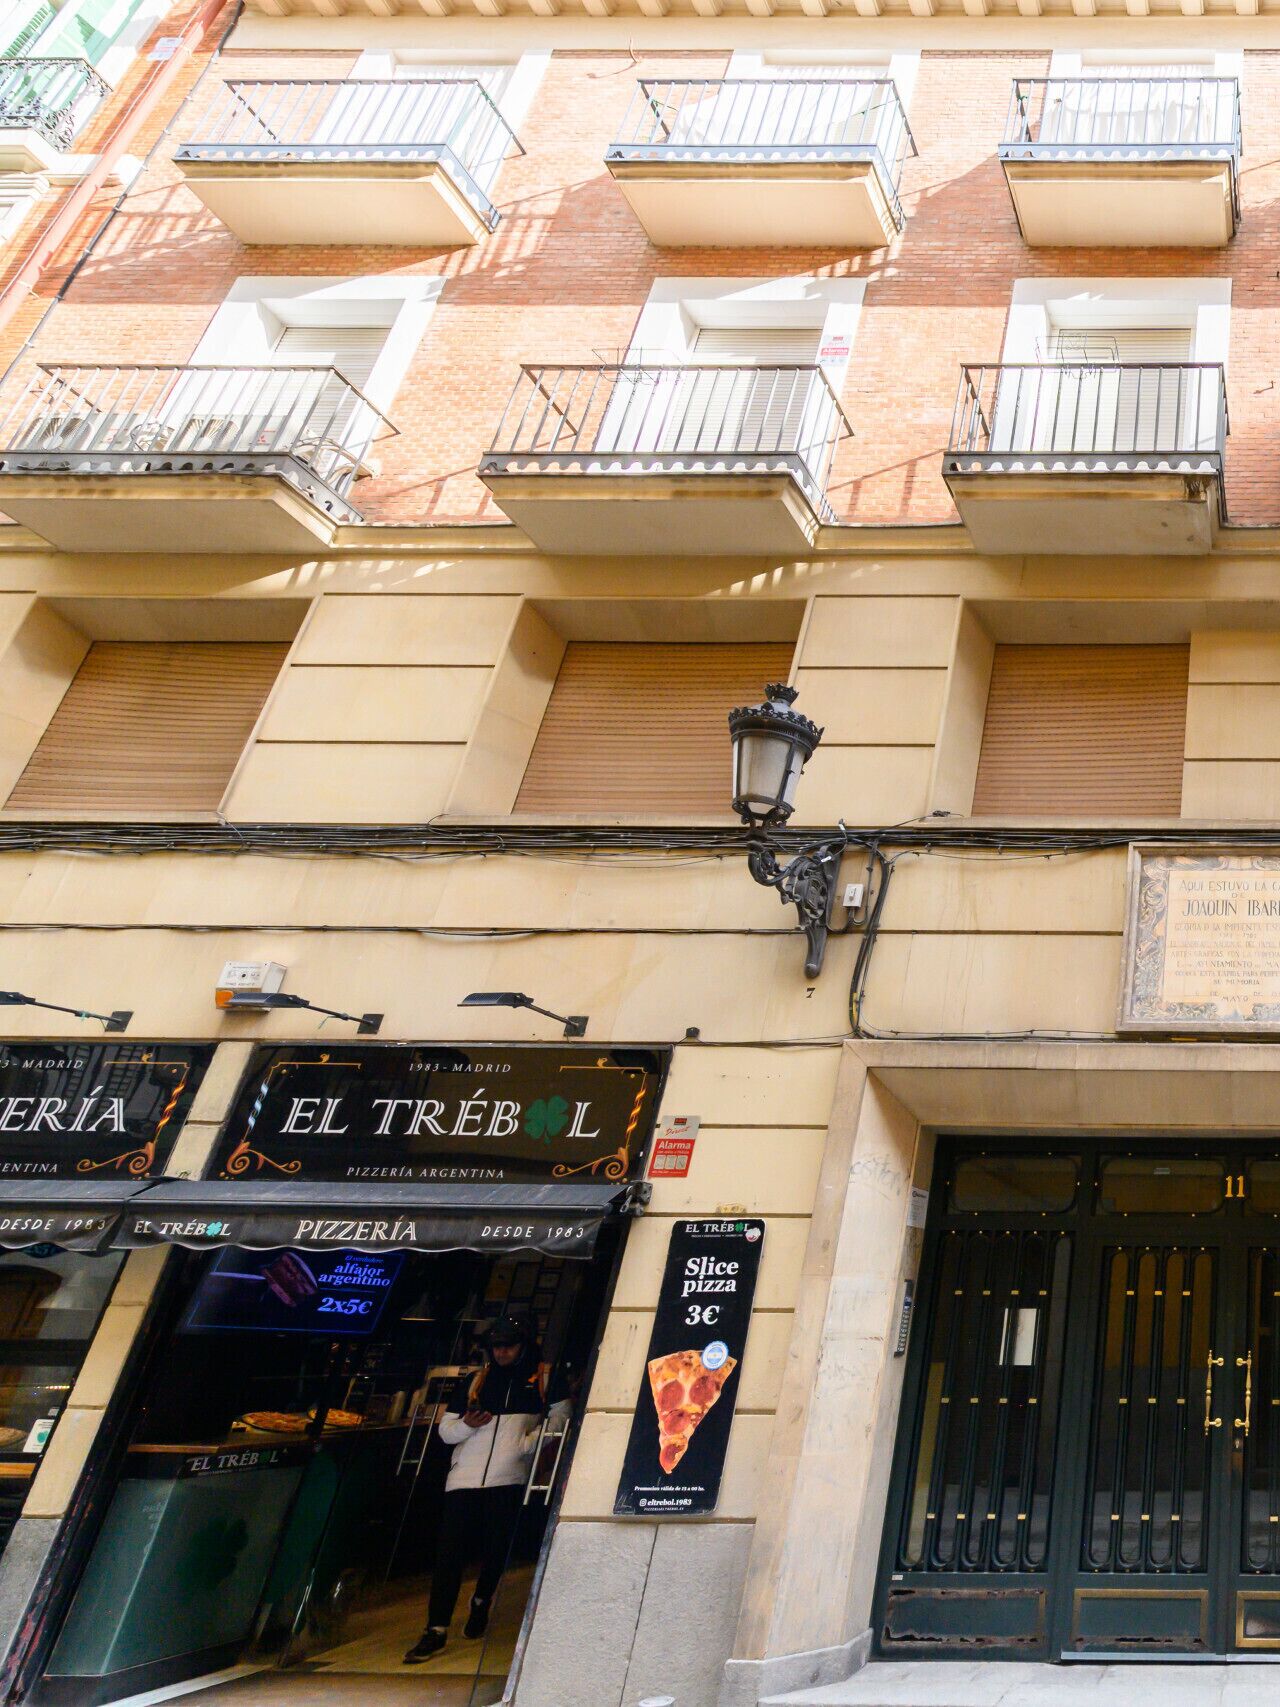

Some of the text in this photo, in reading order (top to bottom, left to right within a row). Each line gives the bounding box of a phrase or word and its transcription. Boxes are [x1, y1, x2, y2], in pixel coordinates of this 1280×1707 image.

[1209, 880, 1250, 891] ESTUVO
[1255, 881, 1267, 891] LA
[806, 988, 816, 999] 7
[22, 1059, 84, 1069] MADRID
[452, 1063, 512, 1073] MADRID
[0, 1086, 127, 1132] ERÍA
[278, 1097, 350, 1135] EL
[658, 1140, 691, 1150] Alarma
[0, 1163, 59, 1173] ENTINA
[346, 1166, 505, 1179] PIZZERÍA ARGENTINA
[1225, 1175, 1245, 1198] 11
[0, 1218, 106, 1231] DESDE 1983
[134, 1220, 152, 1234] EL
[293, 1215, 417, 1241] PIZZERÍA
[685, 1224, 700, 1233] EL
[481, 1225, 585, 1239] DESDE 1983
[334, 1262, 385, 1278] alfajor
[684, 1256, 740, 1277] Slice
[318, 1273, 391, 1287] argentino
[681, 1274, 737, 1298] pizza
[317, 1297, 374, 1315] 2x5€
[685, 1304, 720, 1326] 3€
[190, 1456, 212, 1472] EL
